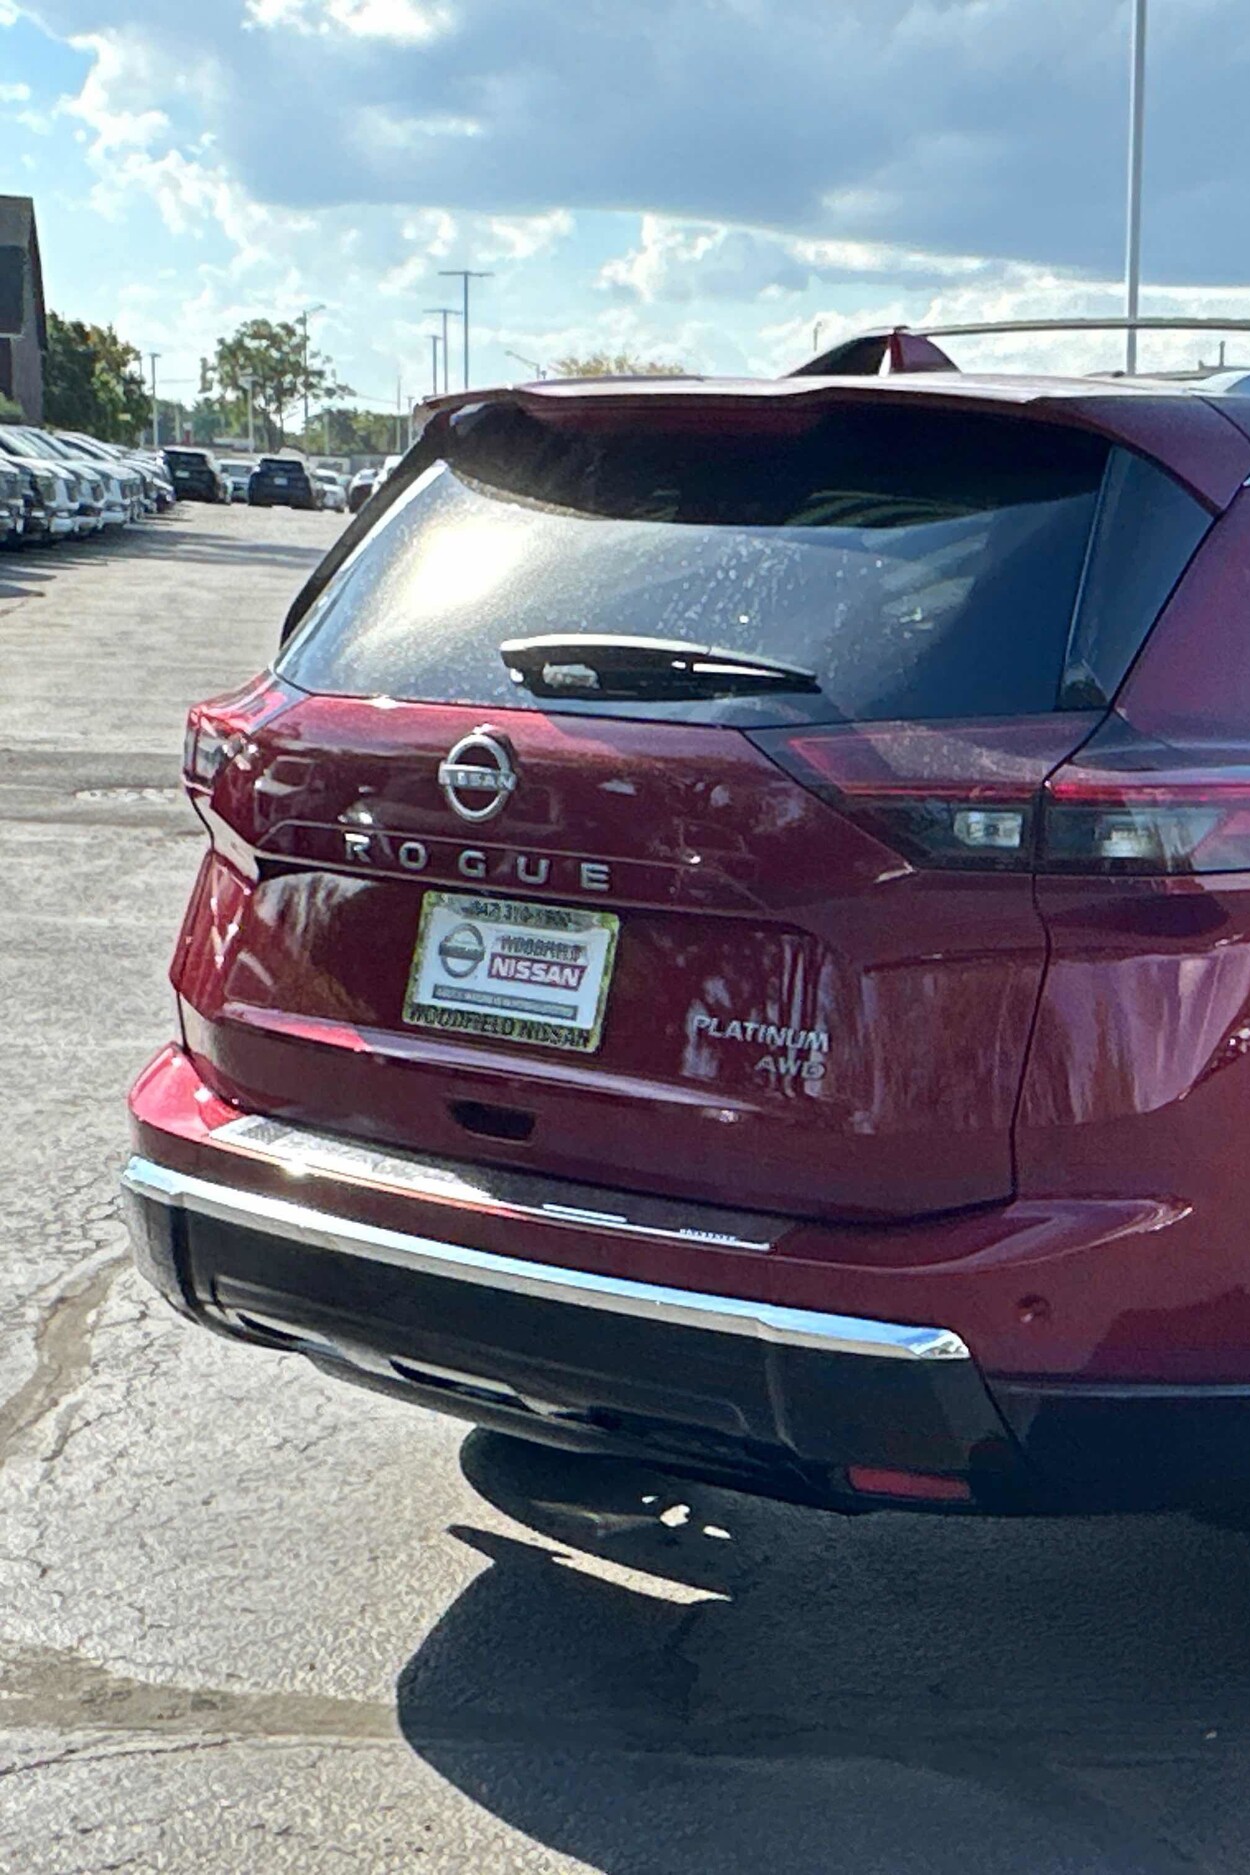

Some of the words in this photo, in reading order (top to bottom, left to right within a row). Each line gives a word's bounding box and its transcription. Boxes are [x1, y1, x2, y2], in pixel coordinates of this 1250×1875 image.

[438, 766, 516, 791] NSSAN
[344, 833, 610, 892] ROGUE
[491, 957, 580, 987] NISSAN
[409, 1005, 515, 1036] WOODFIELD
[693, 1014, 829, 1053] PLATINUM
[754, 1055, 826, 1079] AWD
